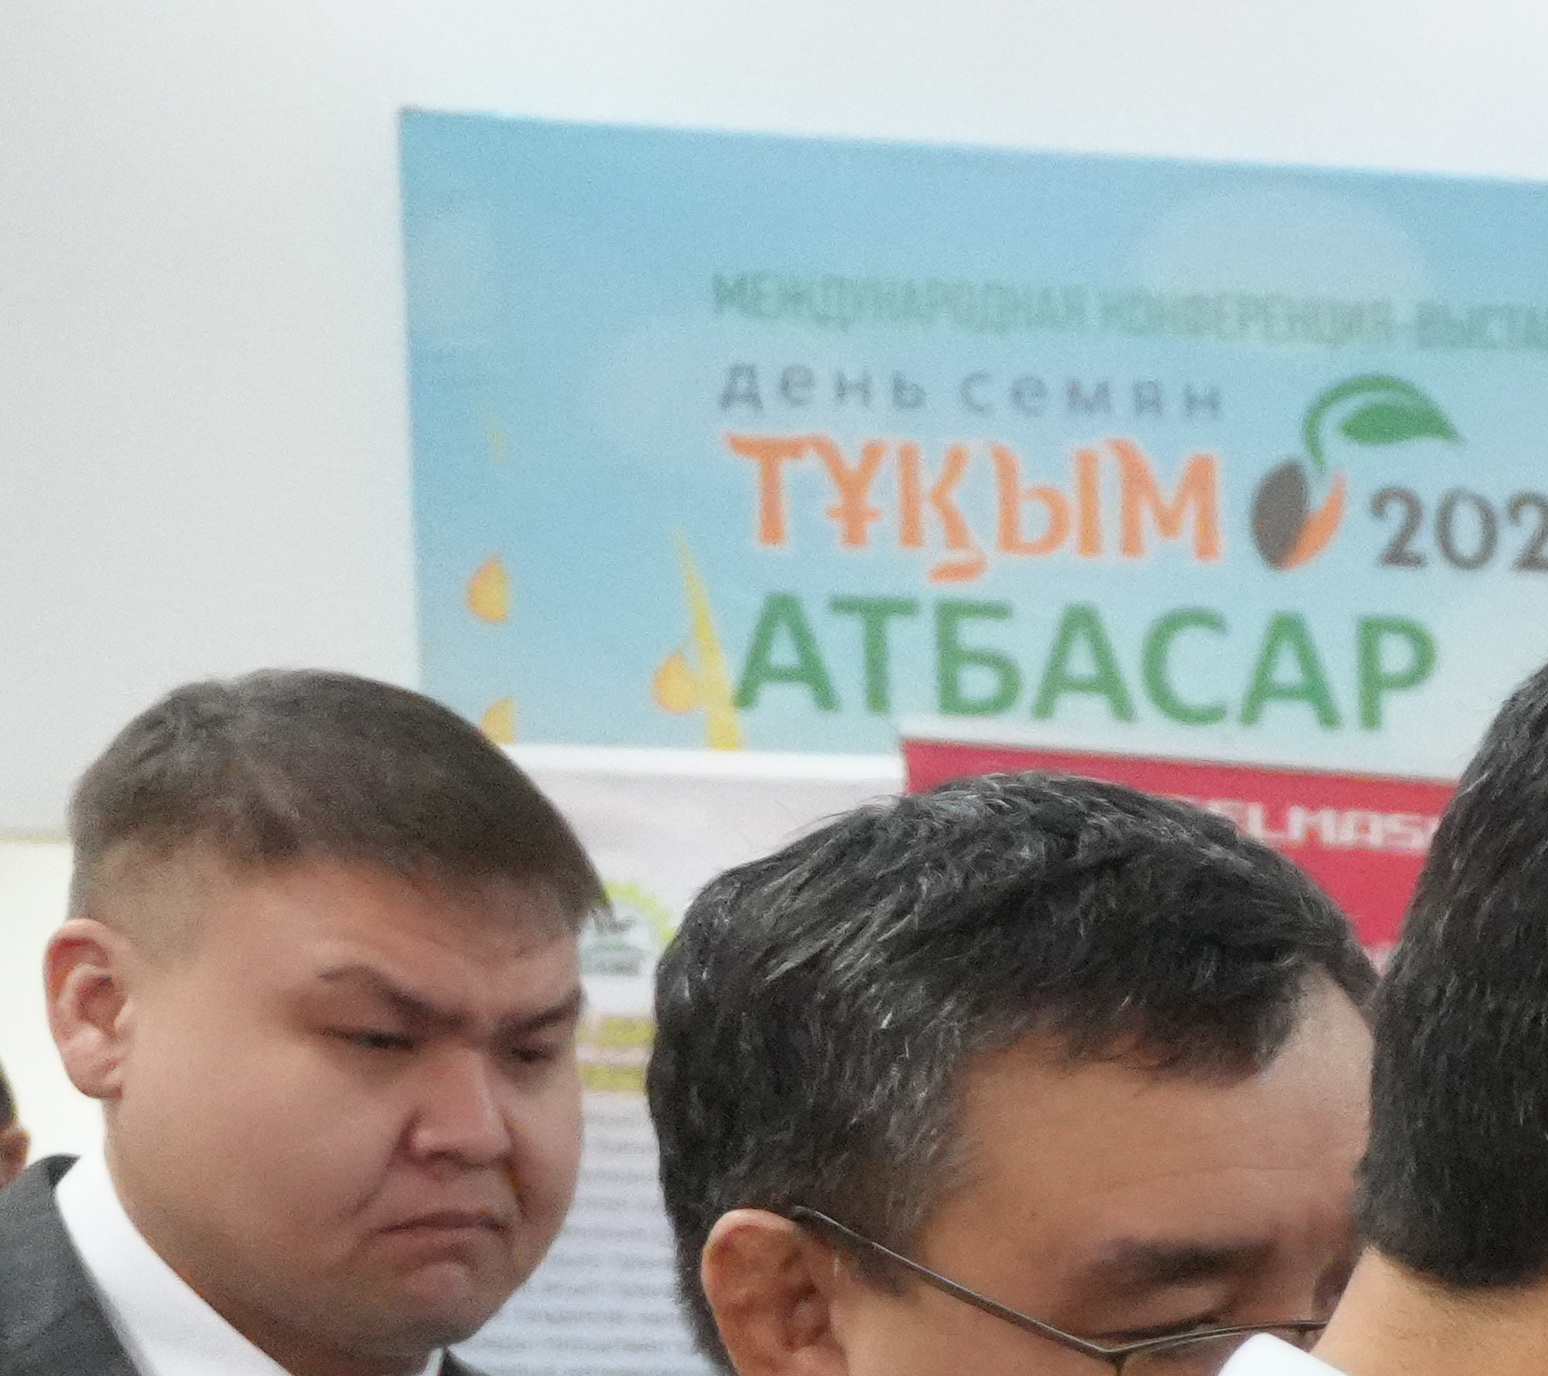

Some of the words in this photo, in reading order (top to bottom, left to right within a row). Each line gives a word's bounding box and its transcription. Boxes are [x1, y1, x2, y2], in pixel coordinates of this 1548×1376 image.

[717, 362, 926, 414] день
[958, 370, 1221, 416] семян
[727, 434, 1221, 583] ТҰҚЫМ
[733, 592, 1438, 732] АТБАСАР
[1204, 799, 1441, 854] ELMAS
